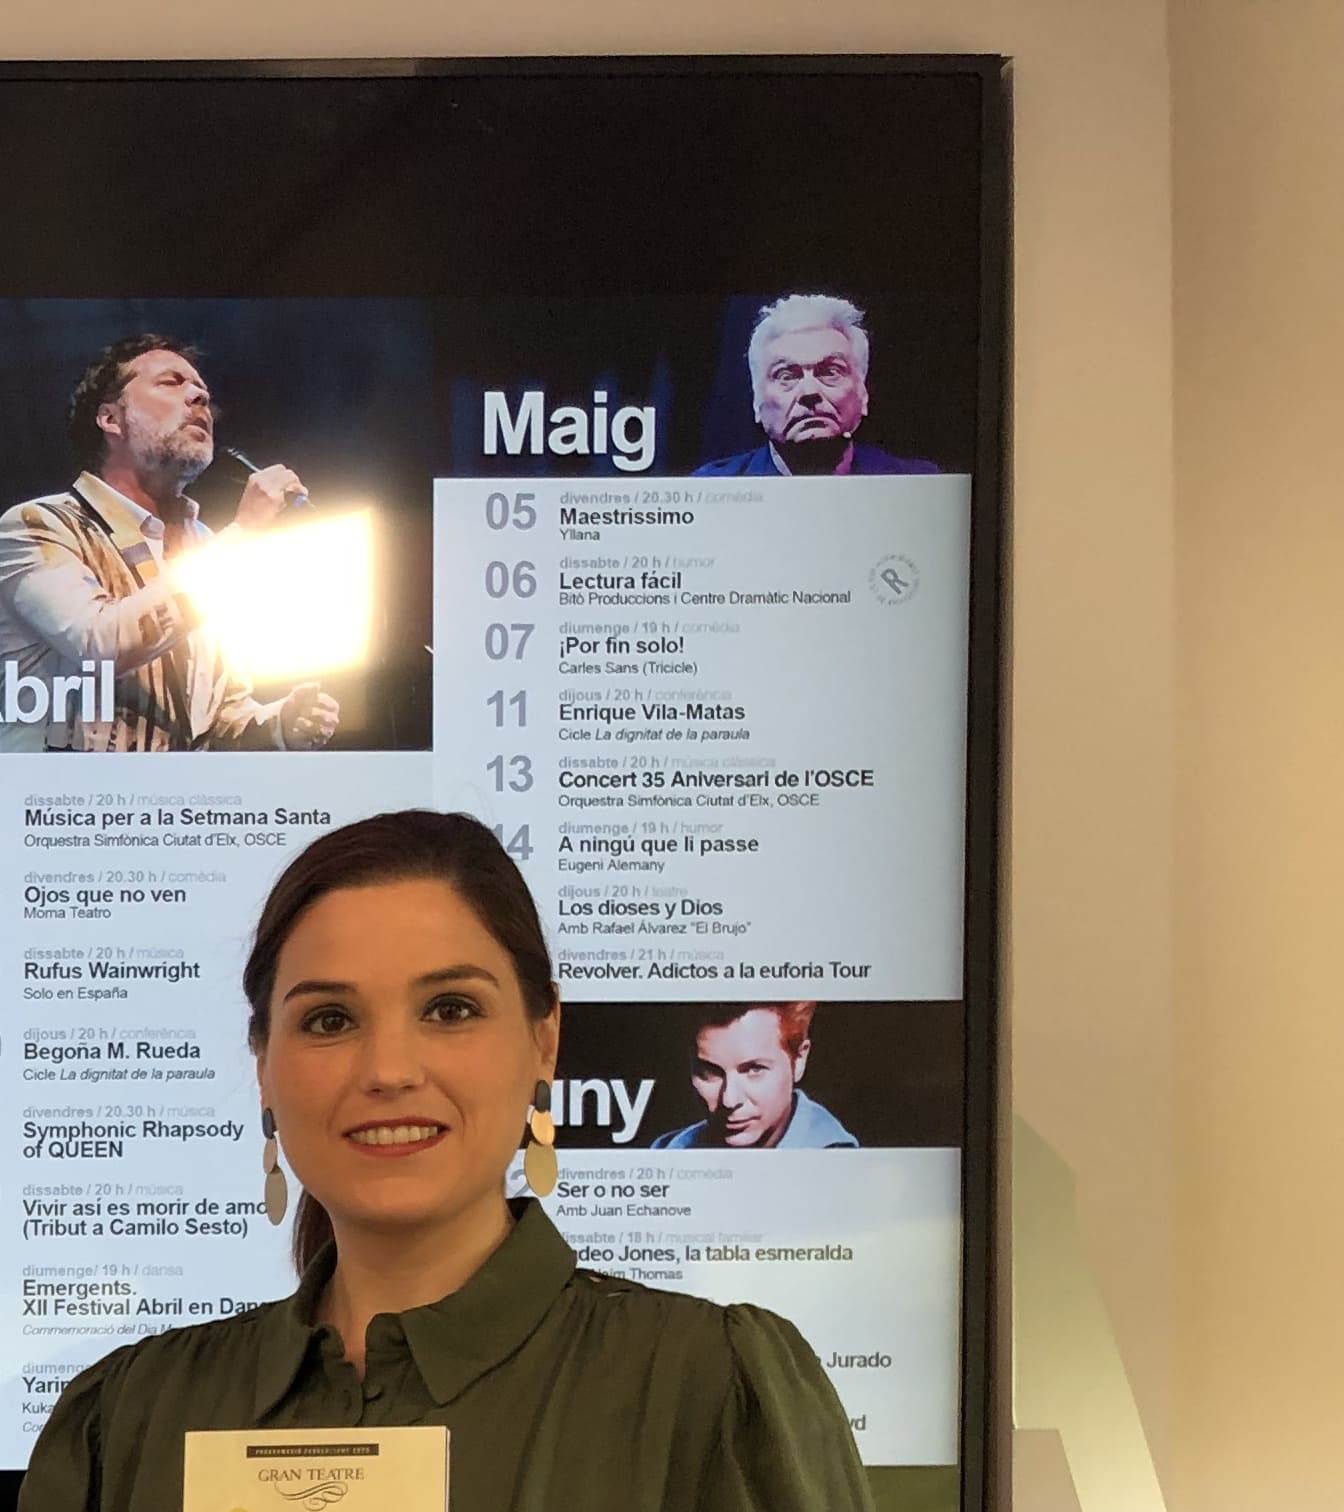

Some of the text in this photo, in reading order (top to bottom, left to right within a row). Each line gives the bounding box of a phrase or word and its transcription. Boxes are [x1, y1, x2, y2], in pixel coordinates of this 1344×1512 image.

[485, 391, 655, 470] Maig
[486, 493, 536, 530] 05
[561, 507, 694, 524] Maestrissimo
[560, 529, 600, 540] Yllana
[486, 561, 536, 598] 06
[485, 623, 535, 660] 07
[487, 690, 526, 727] 11
[560, 704, 745, 724] Enrique Vila-Matas
[487, 755, 533, 792] 13
[559, 770, 874, 788] Concert 35 Aniversari de l'OSCE
[26, 808, 330, 828] Música per a la Setmana Santa
[25, 886, 186, 905] Ojos que no ven
[559, 899, 723, 918] Los dioses y Dios
[25, 962, 200, 982] Rufus Wainwright
[559, 962, 872, 978] Revolver. Adictos a la euforia Tour
[24, 987, 128, 1001] Solo en España
[25, 1042, 200, 1063] Begoña M. Rueda
[618, 1245, 853, 1264] Jones, la tabla esmeralda
[258, 1469, 364, 1481] GRAN TEATRE
